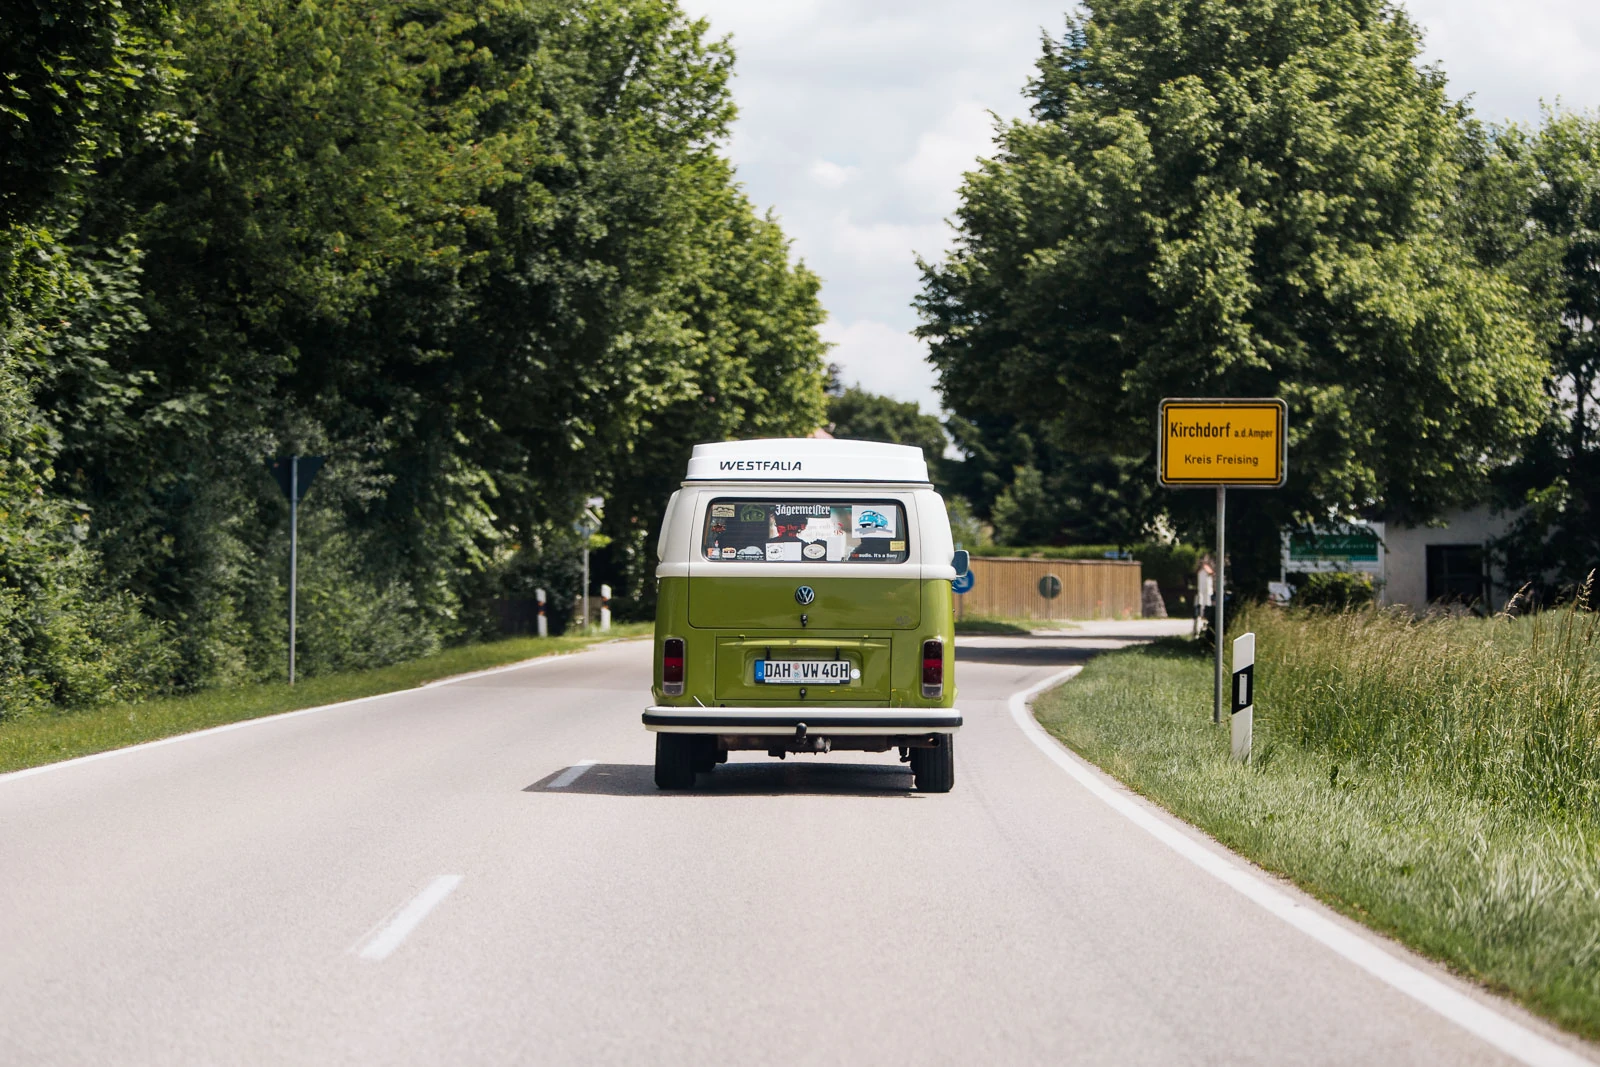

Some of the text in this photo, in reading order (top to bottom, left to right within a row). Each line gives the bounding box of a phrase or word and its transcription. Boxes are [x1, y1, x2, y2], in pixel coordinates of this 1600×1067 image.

[1170, 422, 1231, 438] Kirchdorf
[719, 461, 802, 471] WESTFALIA
[1184, 454, 1259, 467] Kreis Freising
[775, 504, 830, 516] Jägermeister
[764, 663, 791, 678] DAH
[802, 663, 819, 678] VW
[822, 663, 849, 678] 40H
